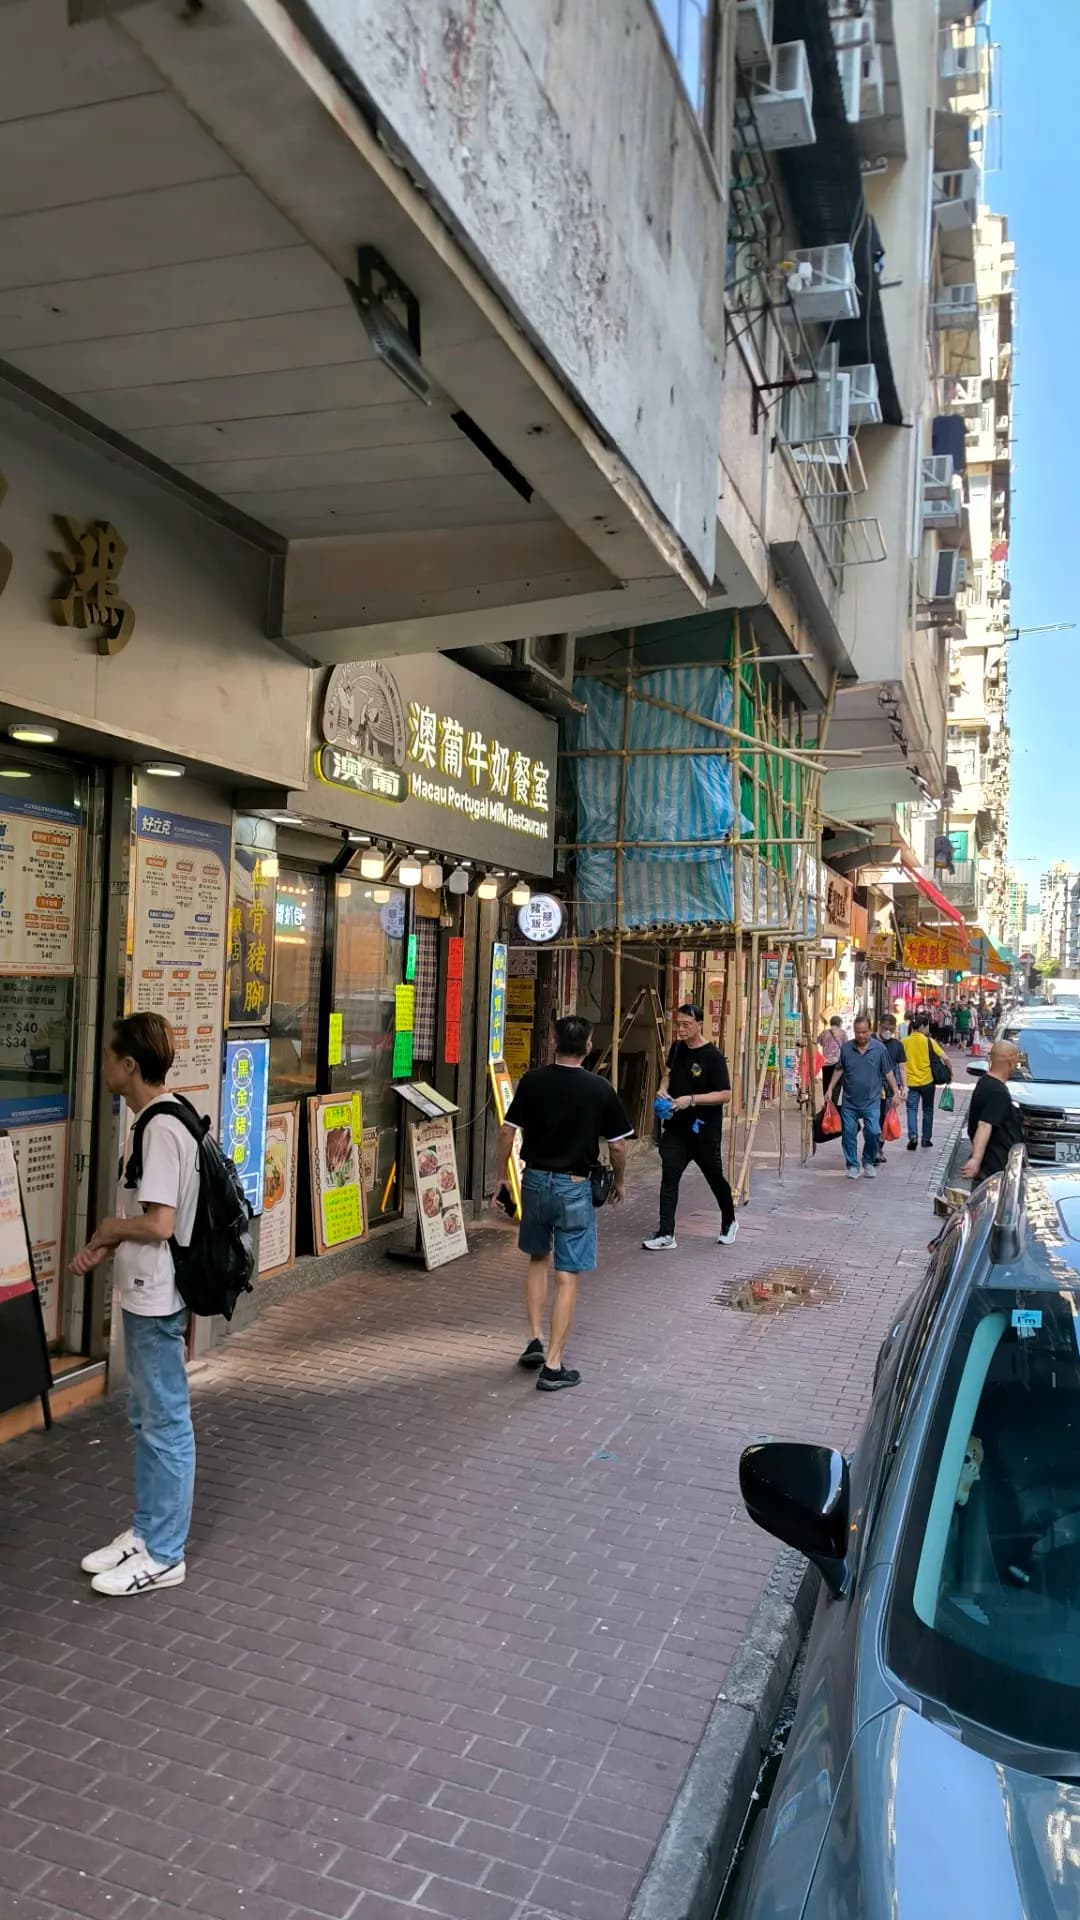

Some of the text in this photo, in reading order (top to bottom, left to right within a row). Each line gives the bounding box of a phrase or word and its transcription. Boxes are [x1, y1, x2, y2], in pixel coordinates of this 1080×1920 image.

[332, 751, 402, 797] 澳葡
[408, 702, 549, 812] 澳葡牛奶餐室
[141, 815, 173, 836] 好立克
[411, 774, 549, 838] Macau Portugal Milk Restaurant
[243, 859, 268, 1013] 無骨豬腳
[6, 1036, 27, 1048] $34
[15, 1021, 38, 1034] $40
